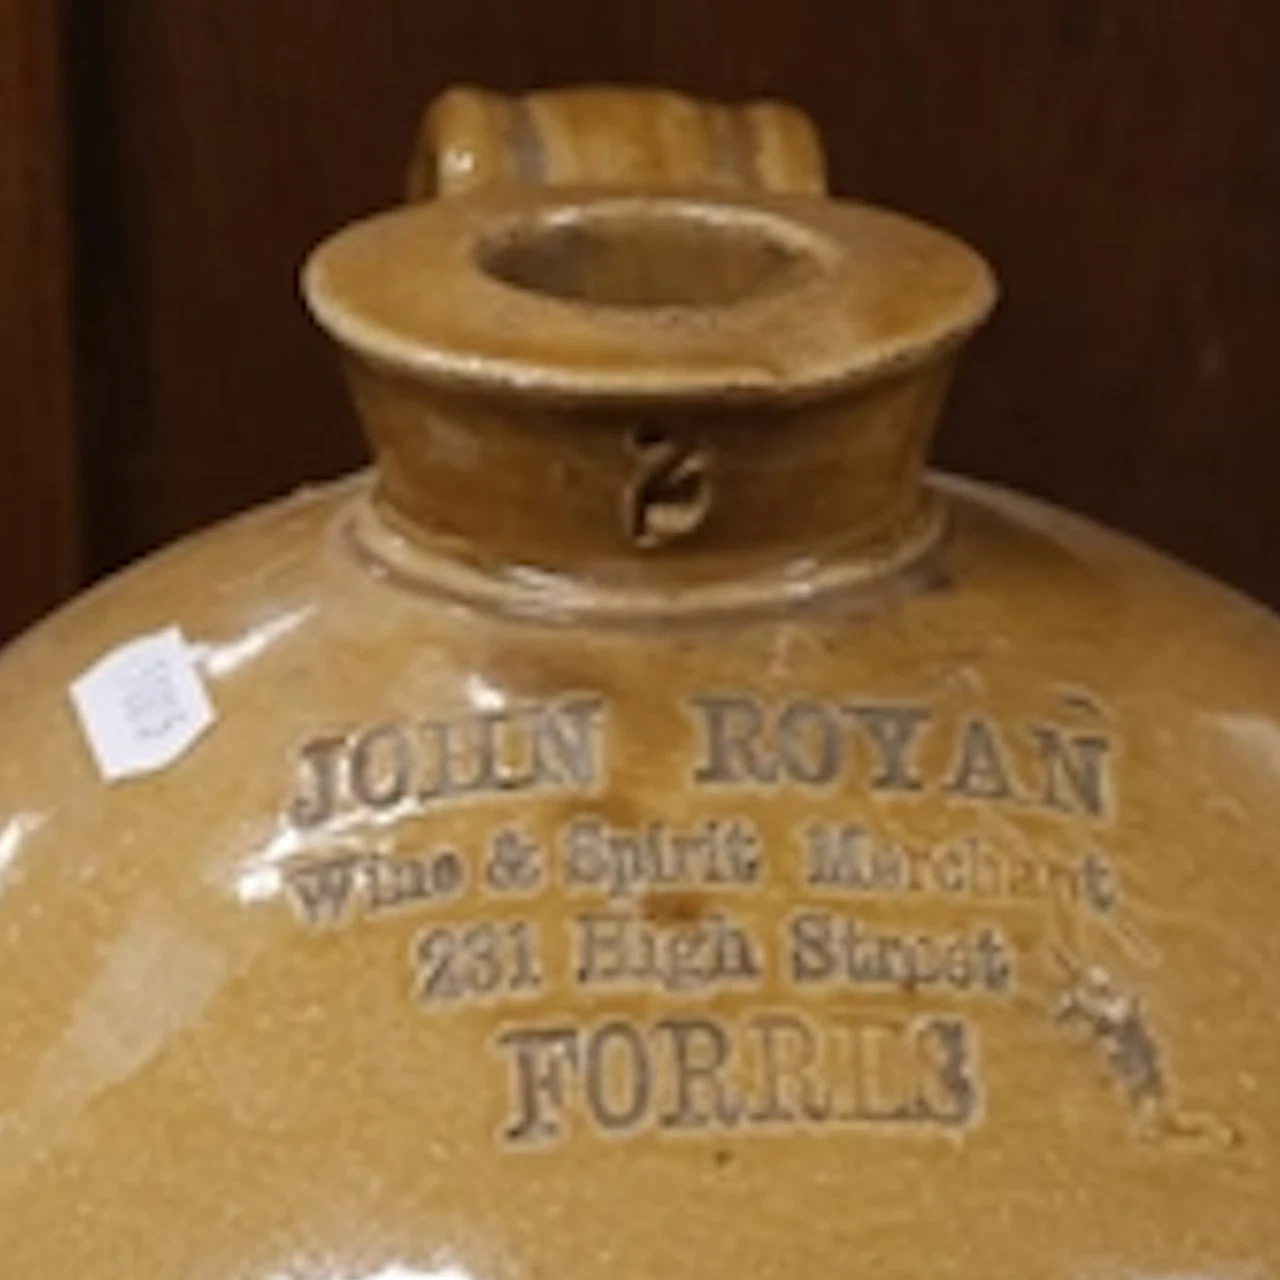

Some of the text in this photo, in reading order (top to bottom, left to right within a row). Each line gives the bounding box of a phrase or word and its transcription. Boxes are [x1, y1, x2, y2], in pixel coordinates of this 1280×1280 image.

[286, 697, 607, 828] JOHN
[689, 696, 1111, 816] ROYAN
[280, 850, 464, 924] Wine
[484, 826, 542, 889] &
[563, 820, 761, 898] Spirit
[416, 910, 1011, 999] 231 High Street
